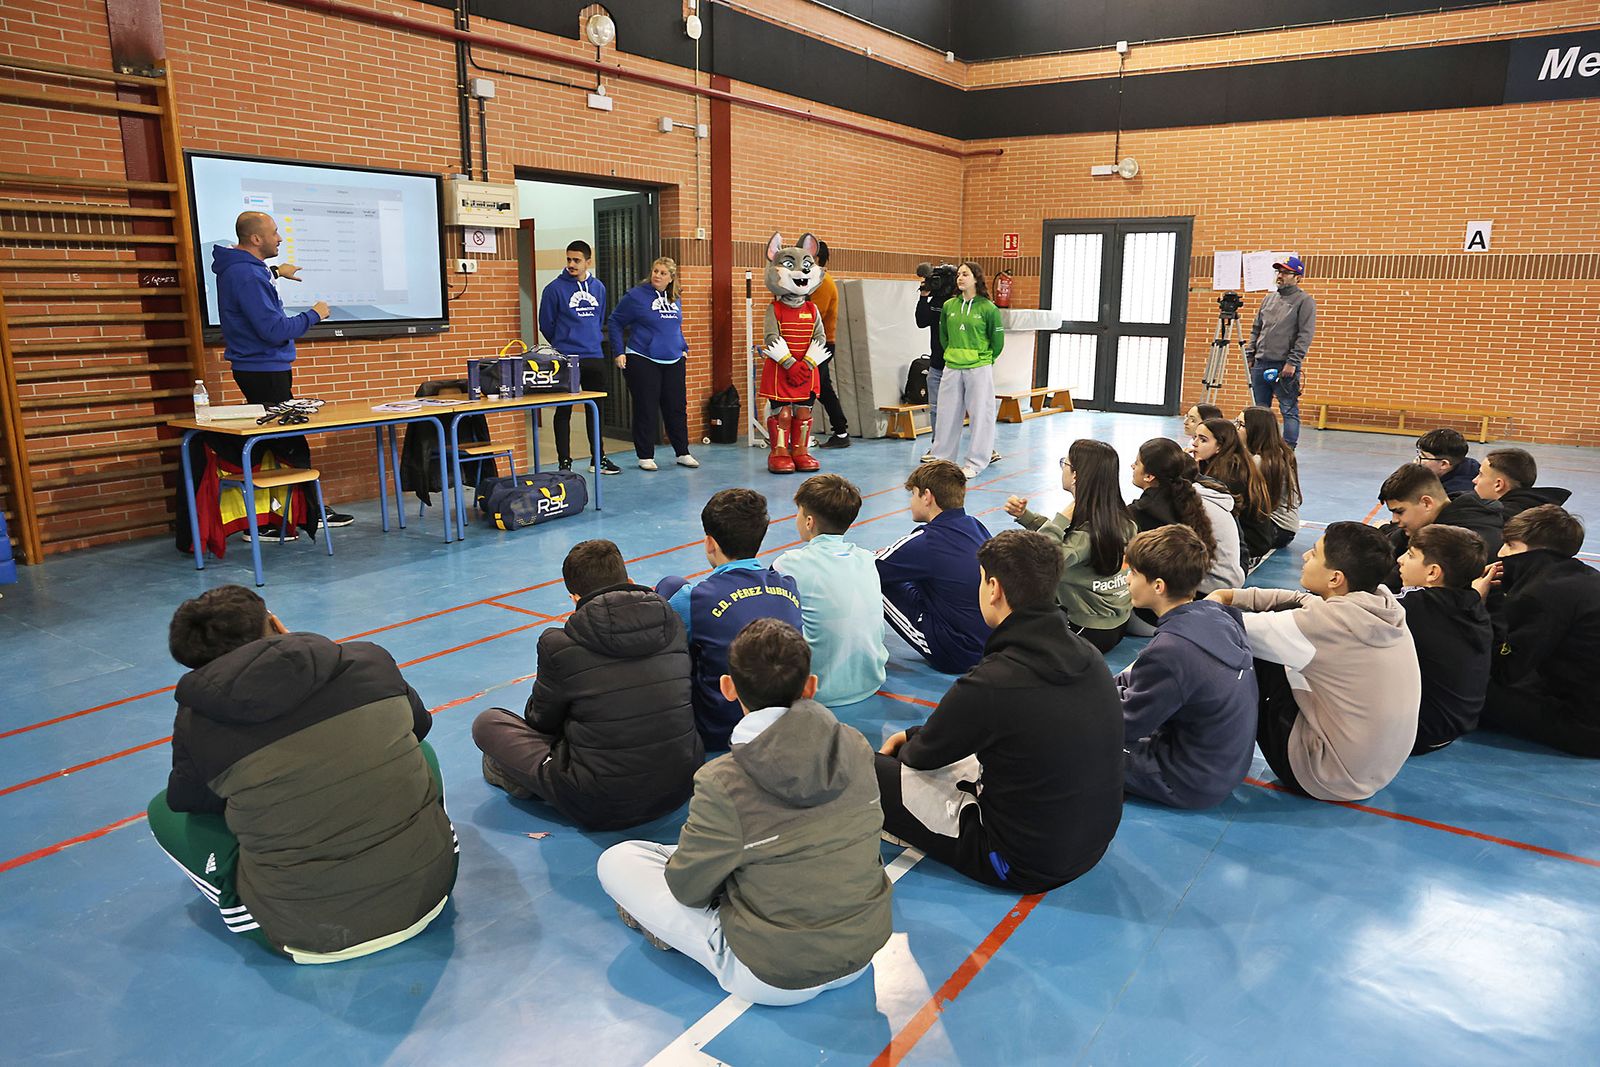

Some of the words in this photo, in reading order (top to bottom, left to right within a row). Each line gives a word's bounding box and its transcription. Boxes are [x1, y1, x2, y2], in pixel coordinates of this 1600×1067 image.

[1537, 46, 1600, 81] Me
[1467, 230, 1486, 250] A
[523, 370, 560, 385] RSL
[537, 494, 569, 514] RSL
[711, 600, 733, 618] C.D.
[729, 586, 763, 602] PÉREZ
